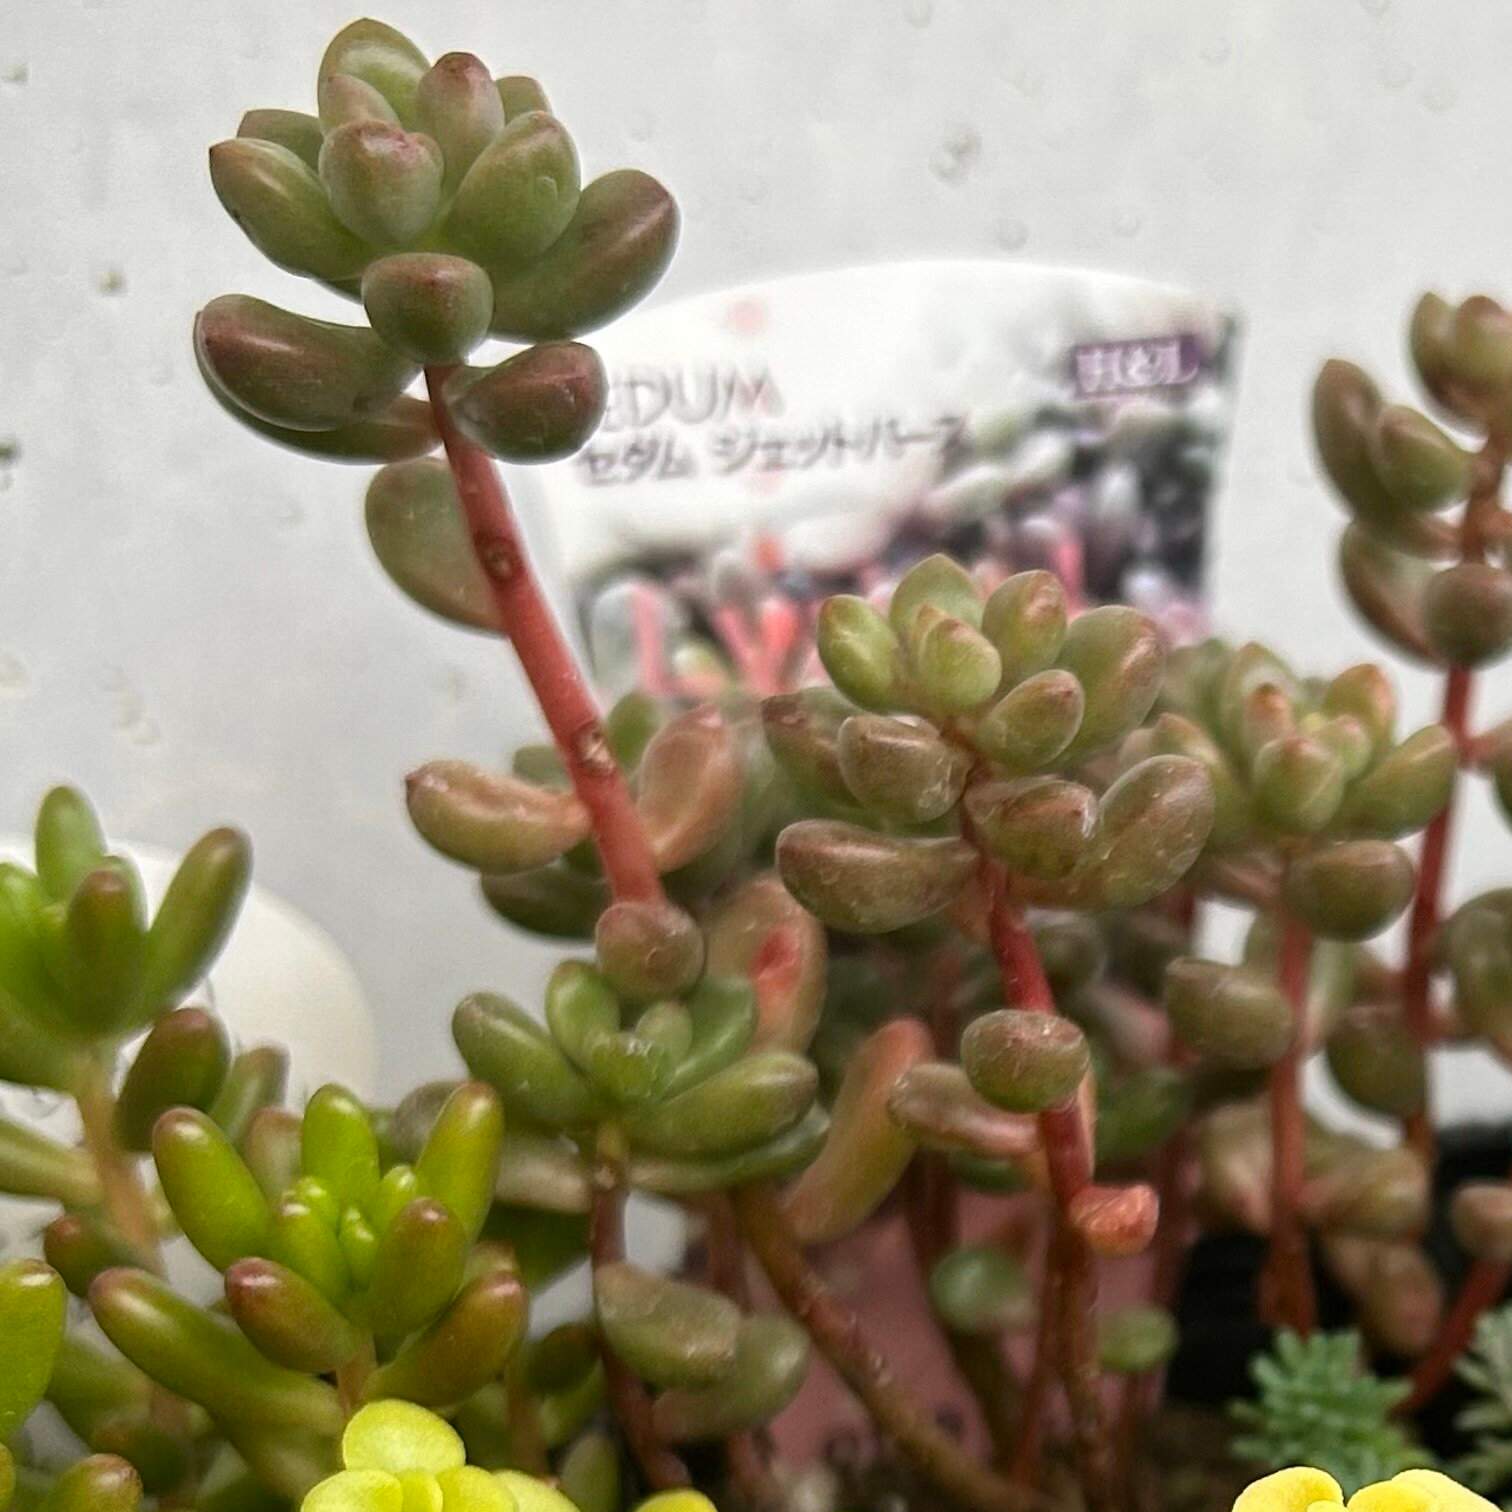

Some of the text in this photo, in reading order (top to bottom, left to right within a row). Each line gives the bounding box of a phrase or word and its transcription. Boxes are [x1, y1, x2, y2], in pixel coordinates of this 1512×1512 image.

[603, 367, 783, 431] EDUM
[581, 432, 696, 484] セダム
